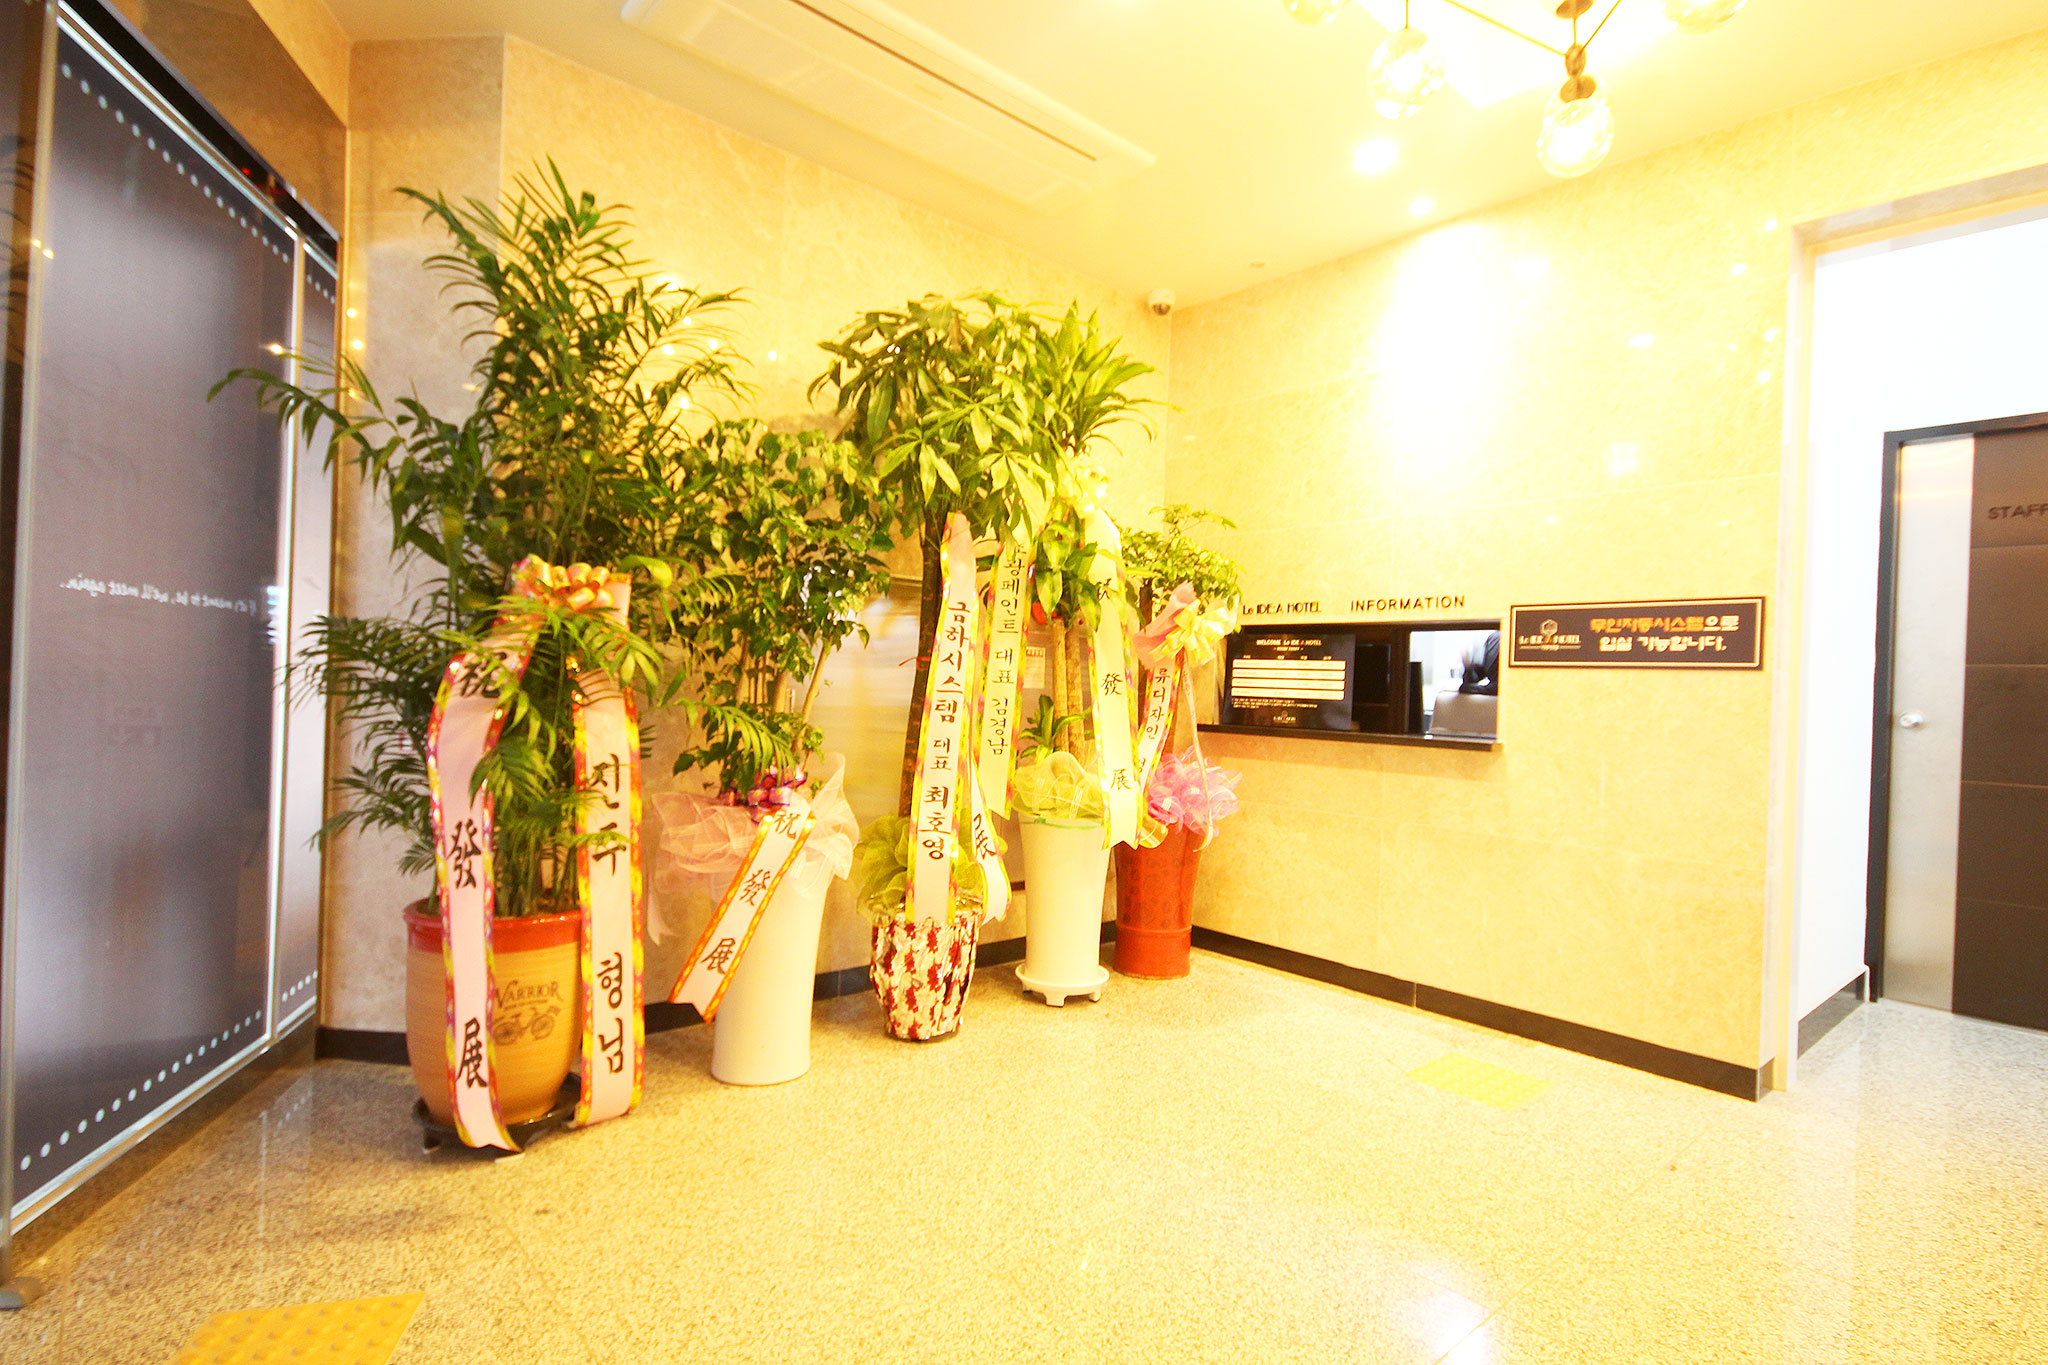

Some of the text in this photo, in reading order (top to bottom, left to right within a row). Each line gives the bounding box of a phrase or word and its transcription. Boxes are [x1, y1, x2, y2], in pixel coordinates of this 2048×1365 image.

[1988, 503, 2048, 520] STAFF
[1287, 601, 1322, 614] HOTEL
[1350, 595, 1465, 613] INFORMATION
[991, 648, 1014, 685] 대표
[1599, 635, 1633, 652] 입실
[918, 601, 971, 861] 금하시스템 대표 최호영
[987, 697, 1008, 756] 김경남
[701, 812, 800, 975] 祝發展
[596, 952, 624, 1074] 형님
